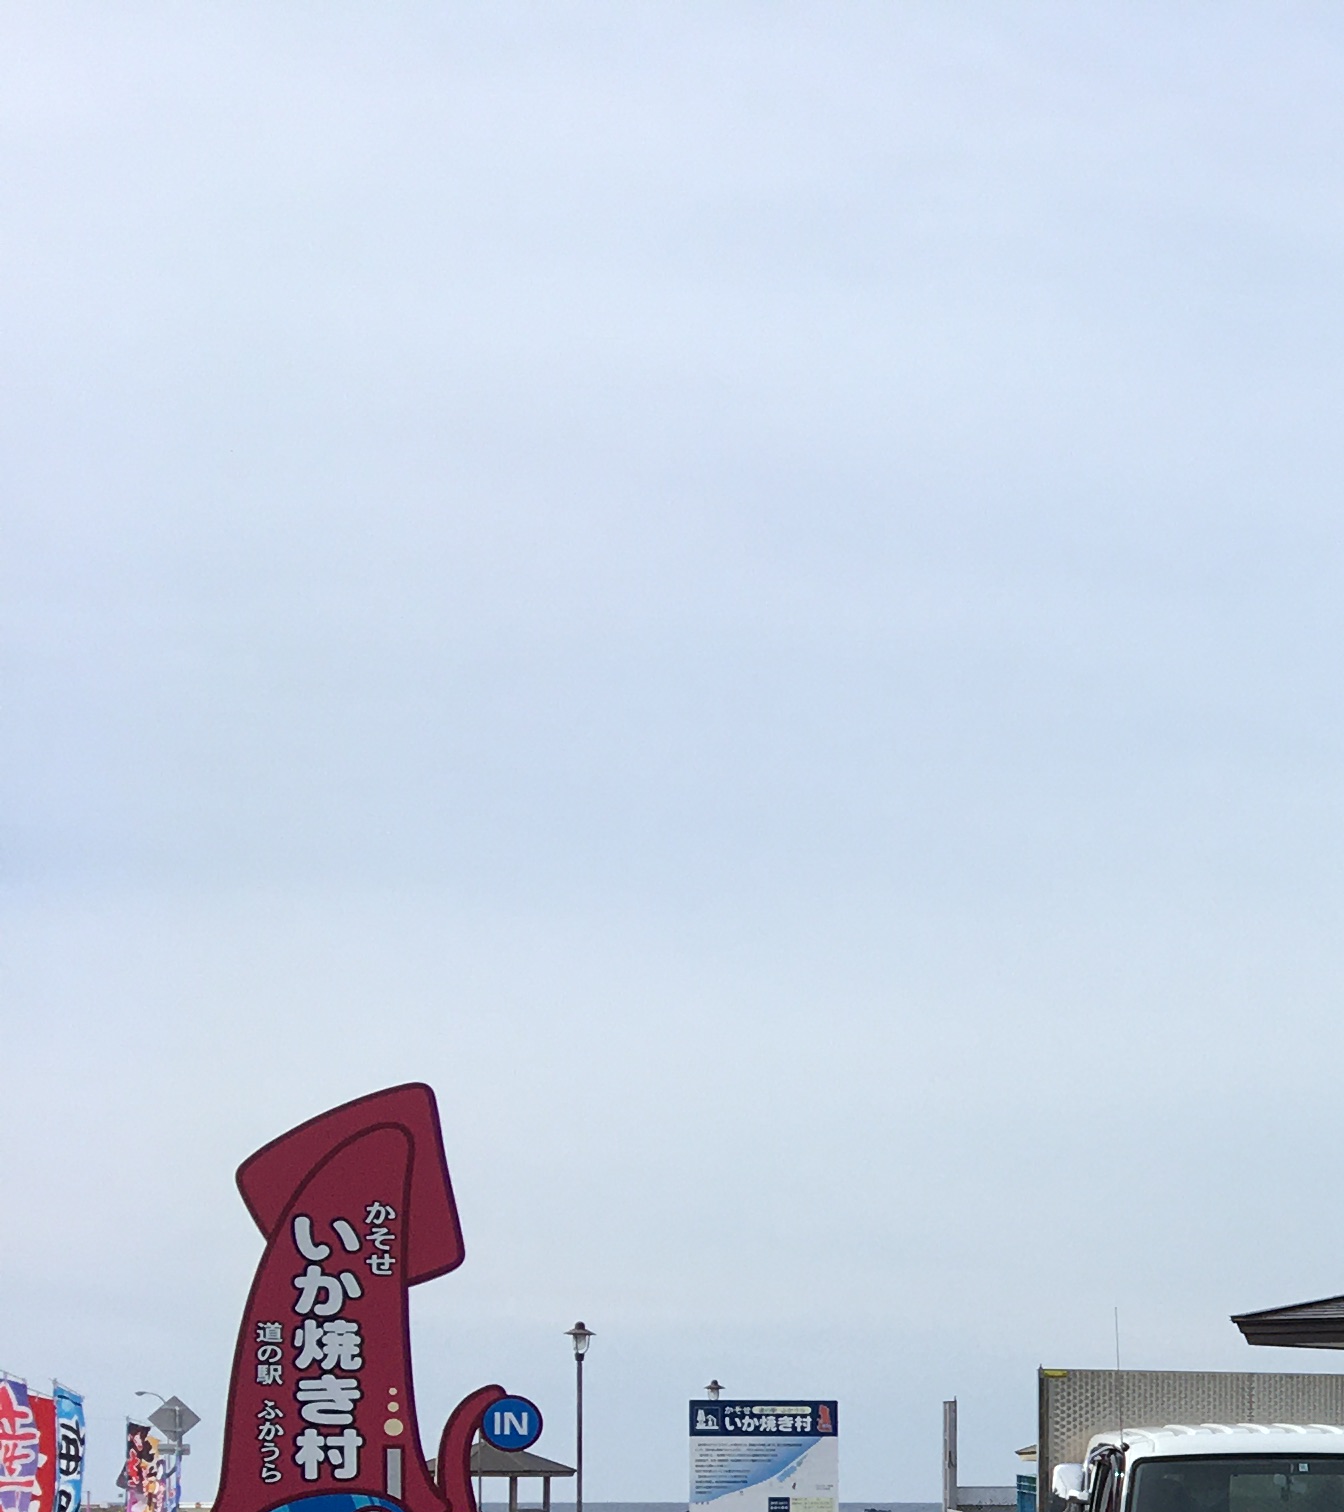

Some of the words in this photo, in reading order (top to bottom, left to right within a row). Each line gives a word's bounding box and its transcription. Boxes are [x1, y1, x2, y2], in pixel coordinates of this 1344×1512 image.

[365, 1201, 396, 1276] かそせ
[256, 1321, 283, 1385] 道の駅
[293, 1215, 363, 1481] いか焼き村
[257, 1400, 284, 1483] ふかうら
[494, 1411, 528, 1436] IN
[724, 1415, 812, 1432] いか焼き村
